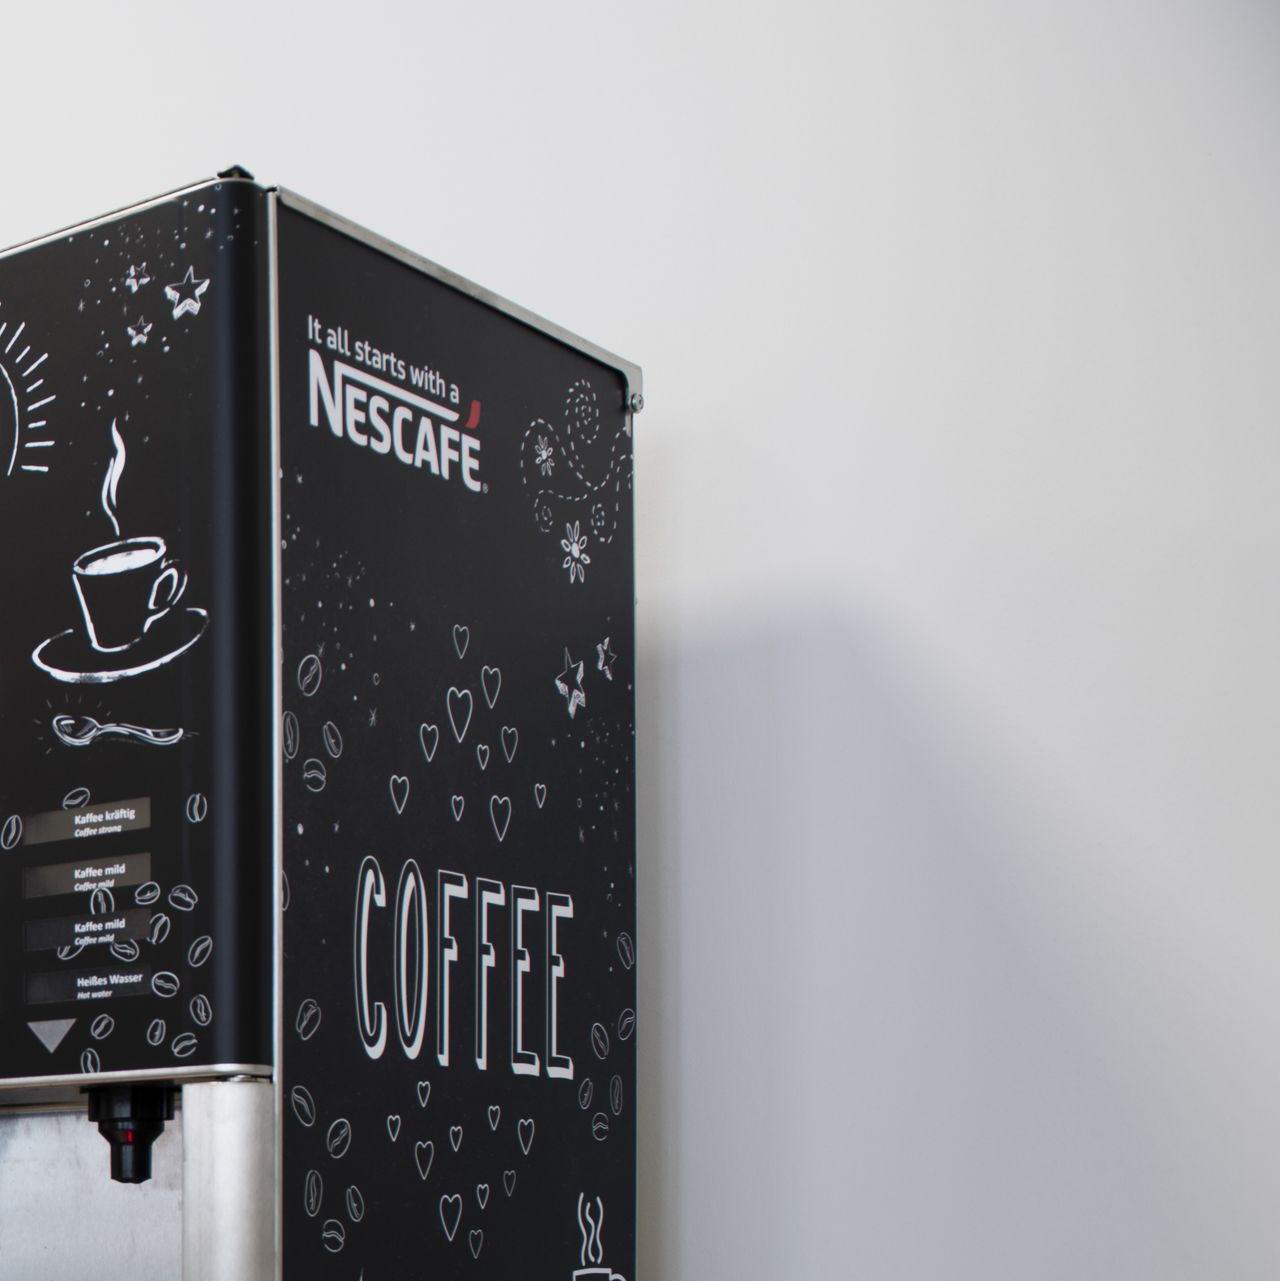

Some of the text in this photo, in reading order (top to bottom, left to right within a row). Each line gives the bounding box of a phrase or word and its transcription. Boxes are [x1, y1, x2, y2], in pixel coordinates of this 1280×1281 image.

[307, 315, 460, 404] It all starts with a
[74, 808, 136, 825] Kaffee kräftig
[74, 825, 122, 838] Coffee strong
[74, 863, 125, 879] Kaffee mild
[74, 879, 115, 892] Coffee mild
[74, 918, 126, 933] Kaffee mild
[74, 933, 115, 946] Coffee mild
[354, 855, 573, 1080] COFFEE
[77, 974, 143, 987] Heißes Wasser
[77, 990, 113, 1000] Hot water
